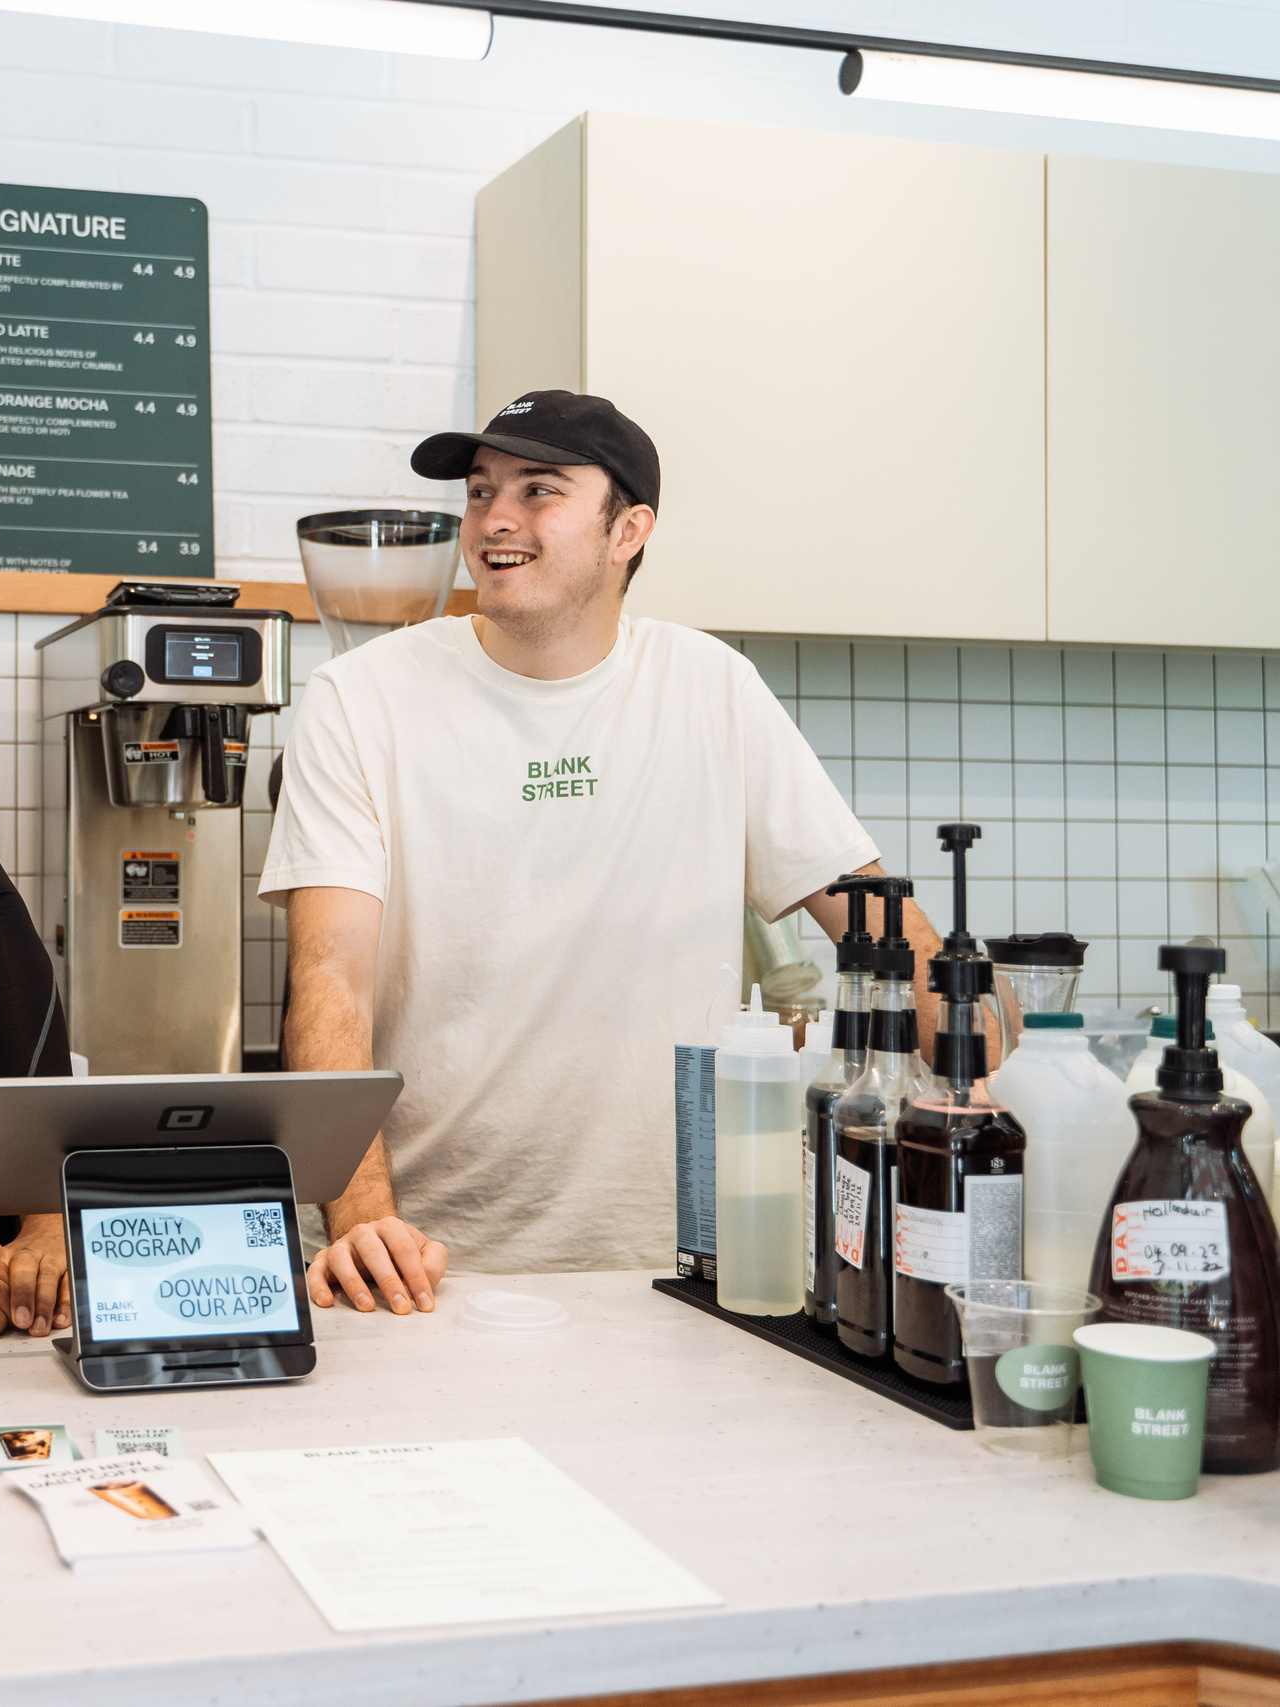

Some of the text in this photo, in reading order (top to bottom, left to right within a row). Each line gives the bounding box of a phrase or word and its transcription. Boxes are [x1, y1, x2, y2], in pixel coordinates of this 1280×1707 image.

[132, 262, 154, 276] 4.4
[174, 265, 196, 279] 4.9
[40, 278, 111, 291] COMPLEMENTED
[112, 282, 124, 291] BY
[8, 324, 49, 339] LATTE
[133, 331, 155, 345] 4.4
[175, 334, 197, 347] 4.9
[8, 347, 54, 357] DELICIOUS
[55, 350, 84, 359] NOTES
[85, 351, 97, 359] OF
[24, 358, 46, 367] WITH
[47, 359, 80, 369] BISCUIT
[82, 362, 123, 372] CRUMBLE
[55, 397, 108, 411] MOCHA
[134, 401, 156, 414] 4.4
[176, 403, 198, 417] 4.9
[45, 418, 117, 430] COMPLEMENTED
[177, 473, 199, 486] 4.4
[10, 487, 57, 497] BUTTERFLY
[58, 489, 75, 497] PEA
[76, 490, 112, 499] FLOWER
[112, 491, 129, 500] TEA
[137, 540, 158, 554] 3.4
[179, 542, 200, 556] 3.9
[30, 559, 58, 567] NOTES
[528, 756, 592, 779] BLANK
[521, 779, 598, 802] STREET
[100, 1217, 184, 1238] LOYALTY
[91, 1237, 201, 1259] PROGRAM
[1115, 1209, 1127, 1273] DAY
[159, 1275, 287, 1299] DOWNLOAD
[97, 1301, 135, 1312] BLANK
[179, 1296, 272, 1318] OUR APP
[95, 1312, 139, 1323] STREET
[1023, 1364, 1066, 1376] BLANK
[1020, 1376, 1068, 1390] STREET
[1134, 1408, 1187, 1421] BLANK
[1131, 1422, 1188, 1436] STREET
[303, 1445, 435, 1458] BLANK STREET
[28, 1464, 168, 1489] DAILY COFFEE
[41, 1459, 142, 1480] YOUR NEW
